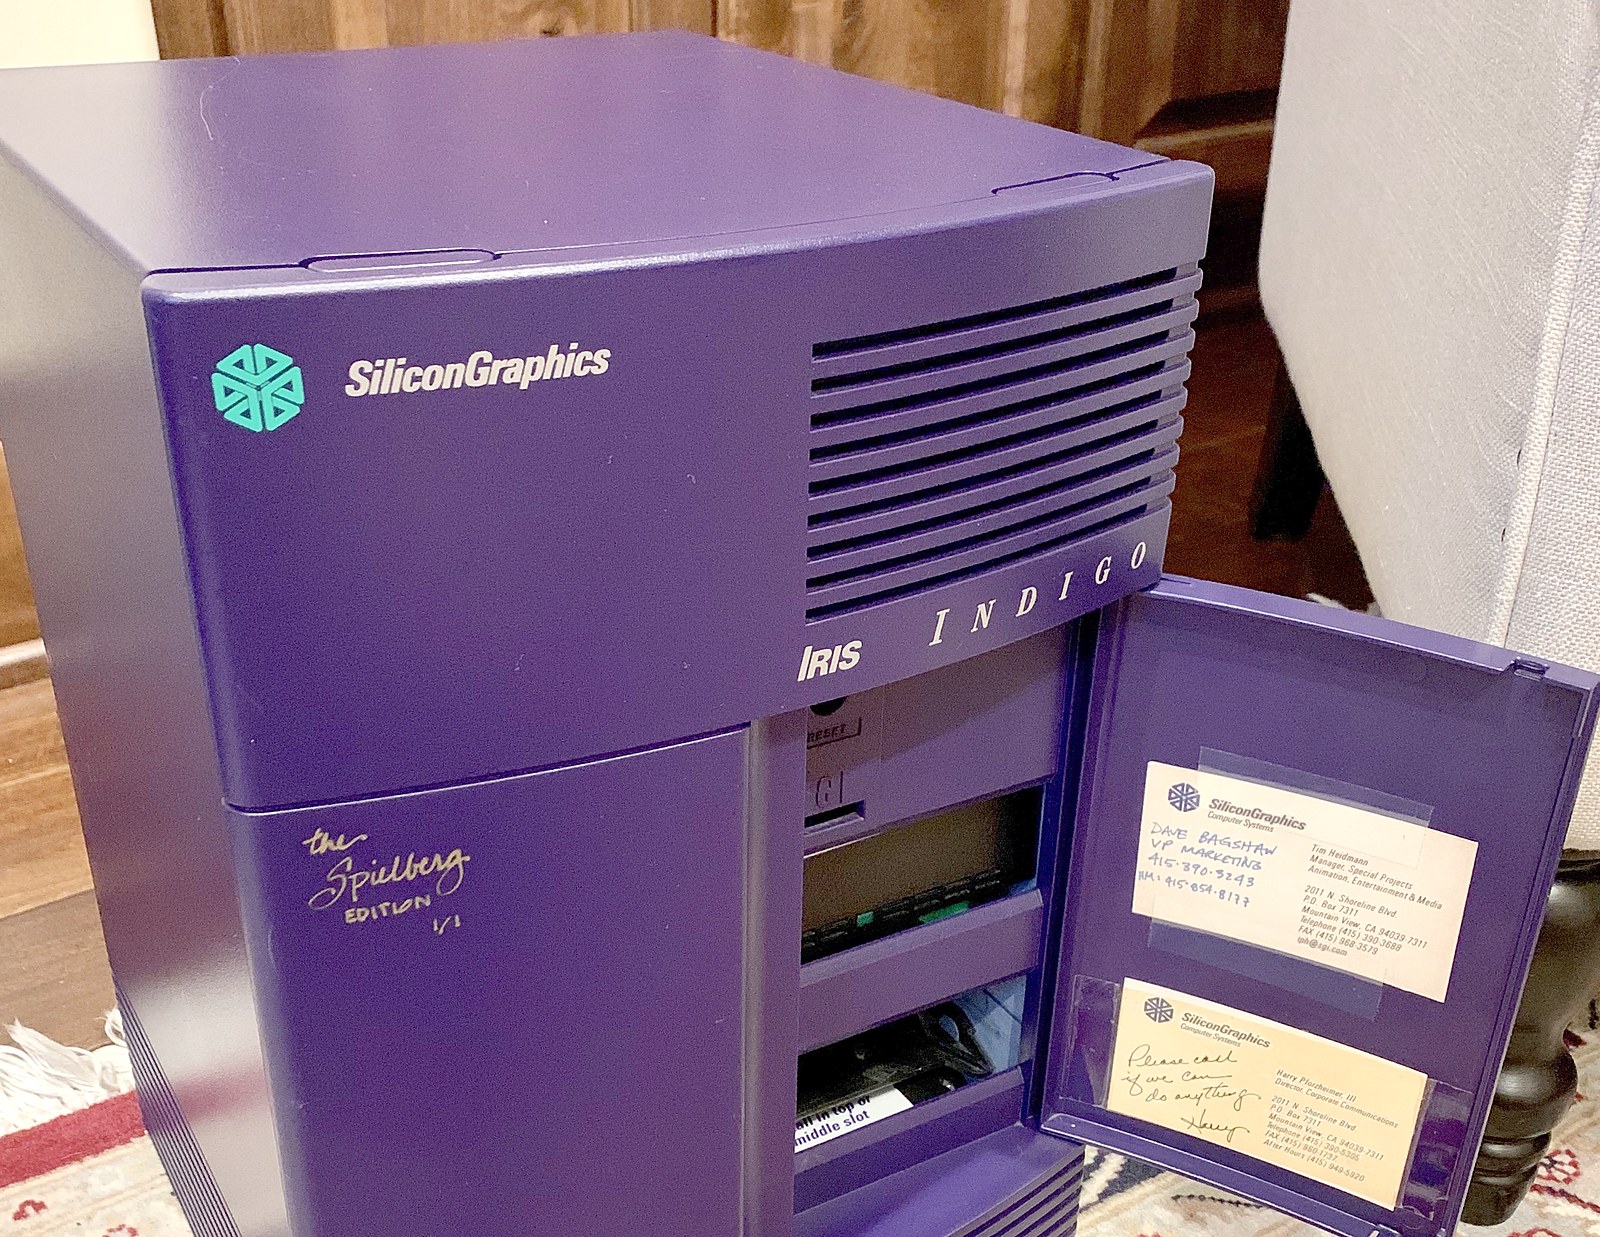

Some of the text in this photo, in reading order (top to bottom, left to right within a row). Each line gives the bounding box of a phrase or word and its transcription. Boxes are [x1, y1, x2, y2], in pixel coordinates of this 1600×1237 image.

[344, 342, 611, 397] SiliconGraphics
[1208, 798, 1306, 831] SiliconGraphics
[1208, 811, 1274, 833] Computer Systems
[302, 827, 368, 854] the
[1150, 822, 1277, 855] DAVE BAGSHAW
[1152, 839, 1262, 870] VP MARKETING
[1312, 844, 1369, 866] Tim Heidmann
[308, 849, 470, 910] Spielberg
[1309, 854, 1413, 890] Manager, Special Projects
[1305, 885, 1324, 896] 2011
[1339, 894, 1376, 912] Shoreline
[1378, 906, 1398, 918] Blvd.
[1308, 865, 1442, 910] Animation, Entertainment & Media
[345, 895, 431, 923] EDITION
[1321, 900, 1336, 910] Box
[1339, 905, 1359, 916] 7311
[1298, 925, 1313, 935] FAX
[1316, 930, 1337, 943] (415)
[1300, 915, 1337, 932] Telephone
[1339, 927, 1361, 940] (415)
[1301, 906, 1339, 922] Mountain
[1365, 924, 1376, 933] CA
[1378, 927, 1427, 949] 94039-7311
[1180, 1023, 1241, 1048] Computer Systems
[1181, 1012, 1271, 1048] SiliconGraphics
[1128, 1044, 1238, 1067] Please call
[1121, 1071, 1143, 1096] if
[1146, 1075, 1174, 1083] we
[1145, 1082, 1261, 1111] do anything
[1277, 1069, 1297, 1082] Harry
[1346, 1094, 1357, 1102] III
[795, 1115, 813, 1131] all
[844, 1110, 870, 1127] slot
[1271, 1095, 1289, 1106] 2011
[1303, 1106, 1337, 1124] Shoreline
[1287, 1110, 1300, 1120] Box
[1303, 1116, 1321, 1127] 7311
[1306, 1089, 1339, 1105] Corporate
[1340, 1101, 1399, 1129] Communications
[1180, 1109, 1250, 1142] Harry
[1265, 1130, 1279, 1139] FAX
[1281, 1136, 1301, 1148] (415)
[1267, 1121, 1300, 1138] Telephone
[1303, 1134, 1323, 1147] (415)
[1269, 1113, 1303, 1130] Mountain
[1327, 1135, 1337, 1143] CA
[1339, 1139, 1384, 1161] 94039-7311
[1264, 1139, 1282, 1150] After
[1284, 1146, 1306, 1159] Hours
[1306, 1155, 1327, 1168] (415)
